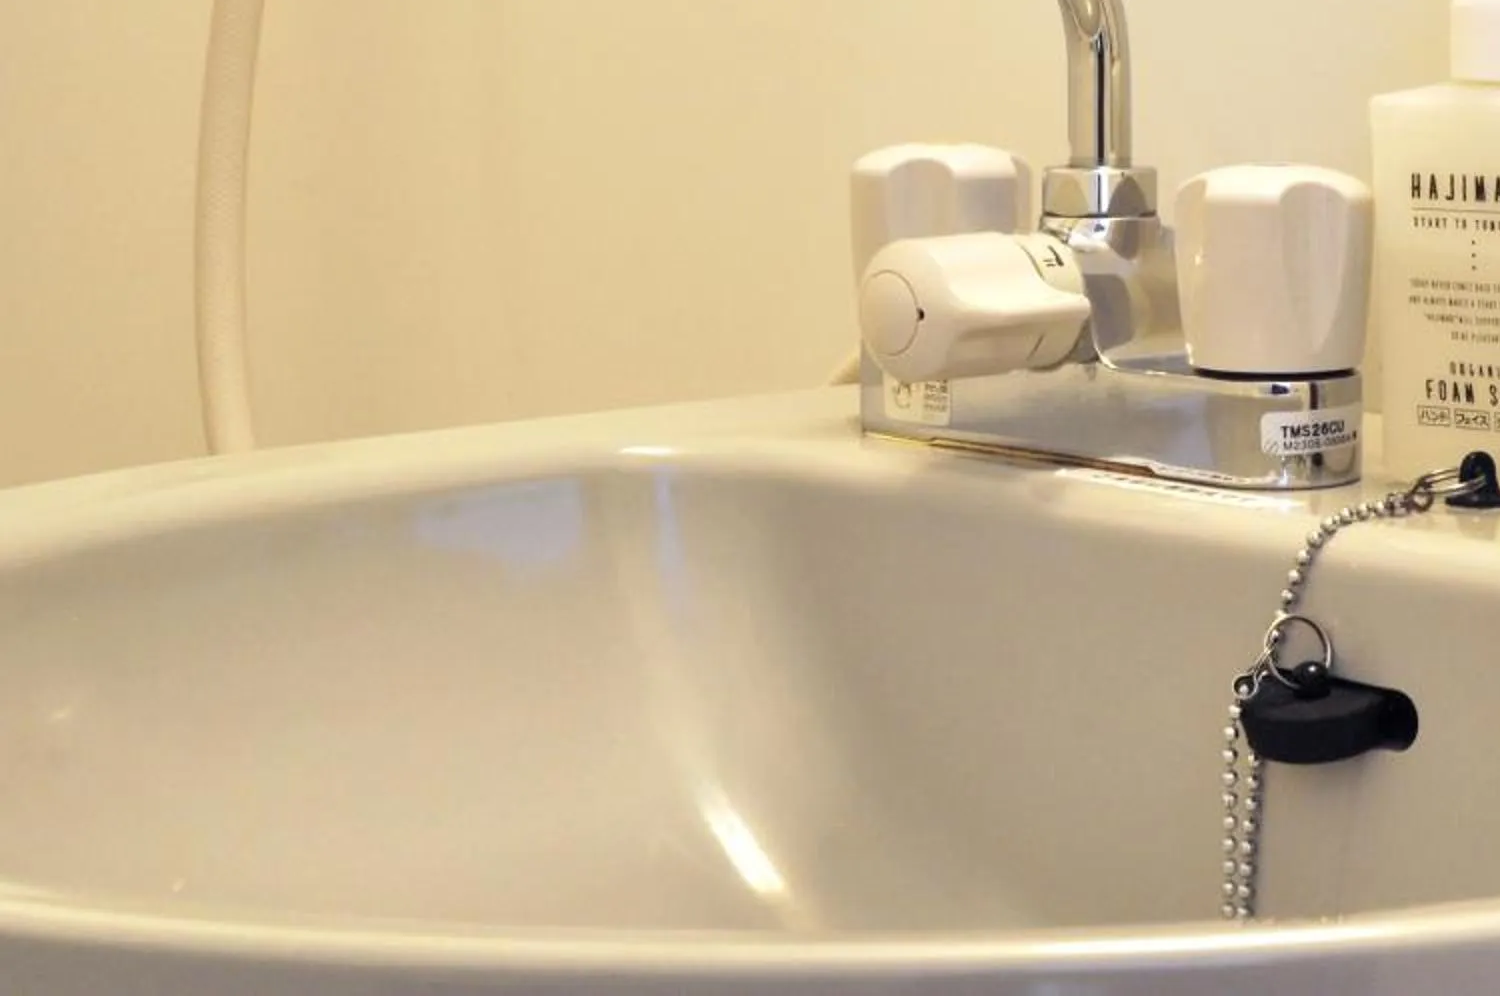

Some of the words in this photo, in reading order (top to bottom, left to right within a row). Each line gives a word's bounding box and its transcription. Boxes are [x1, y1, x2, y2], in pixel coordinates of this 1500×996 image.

[1413, 217, 1447, 229] START
[1456, 218, 1466, 230] TO
[1426, 379, 1474, 404] FOAM
